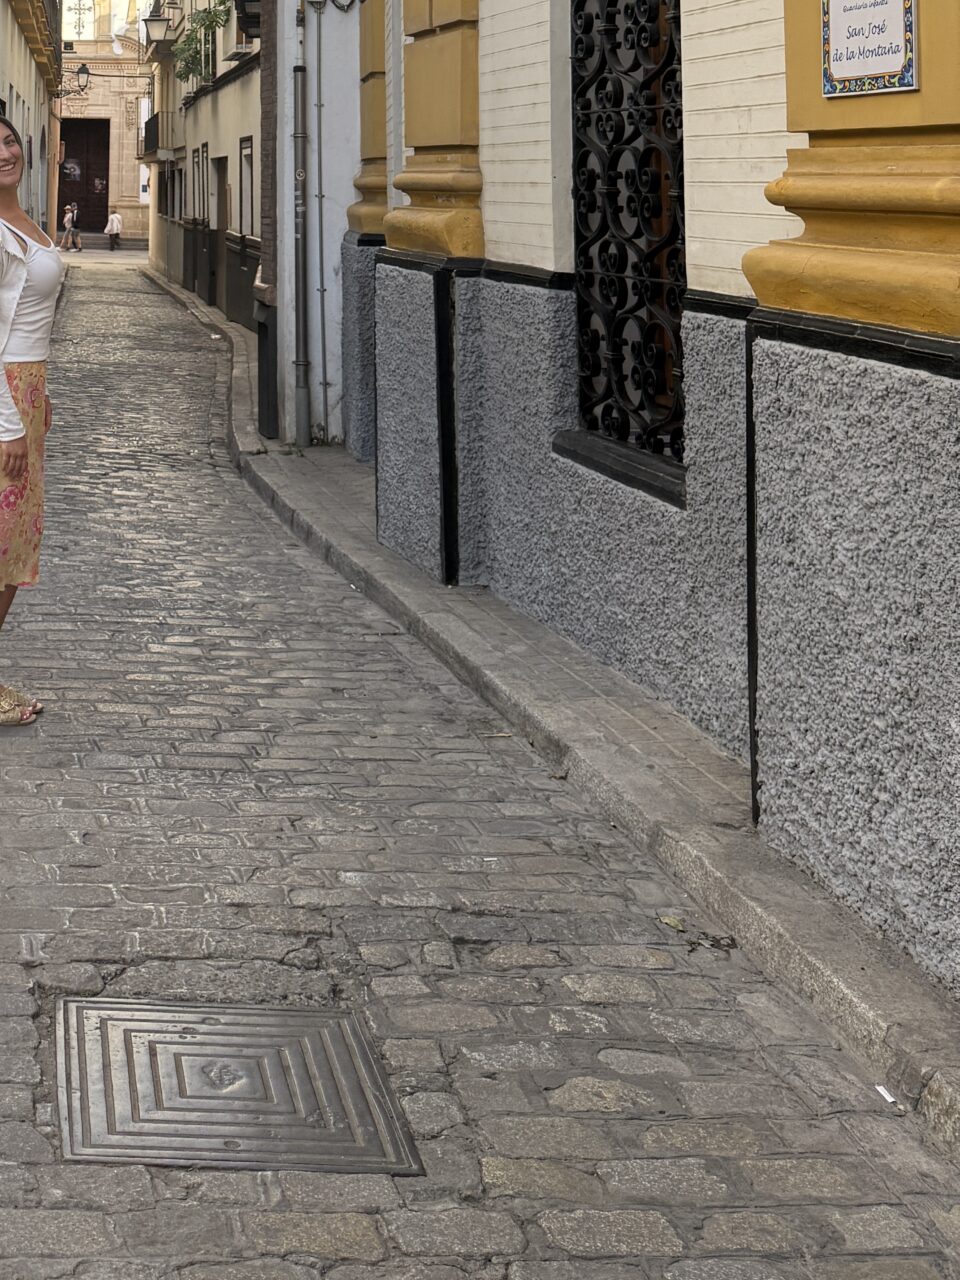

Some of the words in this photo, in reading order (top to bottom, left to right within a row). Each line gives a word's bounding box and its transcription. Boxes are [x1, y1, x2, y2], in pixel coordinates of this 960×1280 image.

[846, 25, 865, 40] San
[865, 19, 888, 39] José
[832, 49, 844, 63] de
[845, 47, 857, 61] la
[857, 42, 902, 60] Montaña
